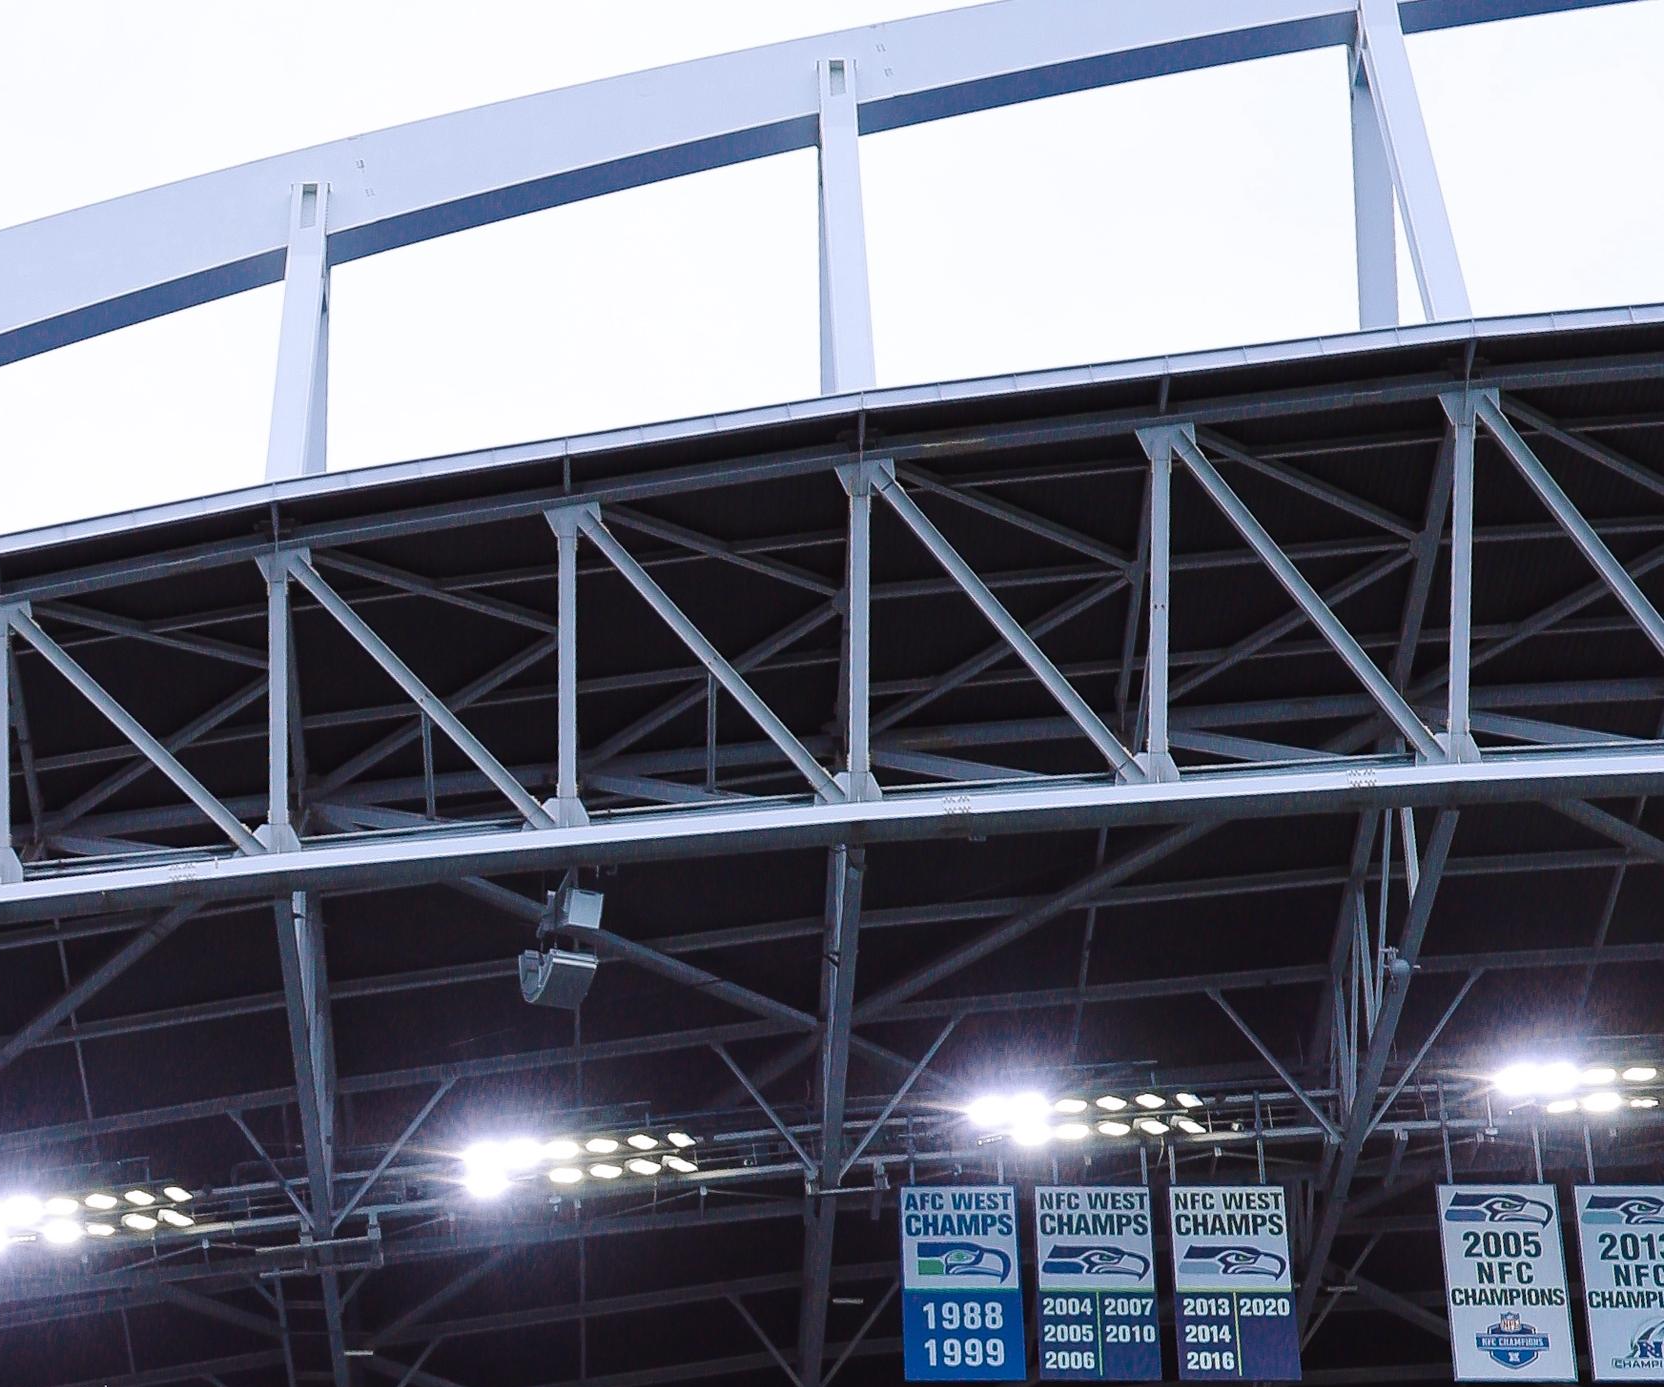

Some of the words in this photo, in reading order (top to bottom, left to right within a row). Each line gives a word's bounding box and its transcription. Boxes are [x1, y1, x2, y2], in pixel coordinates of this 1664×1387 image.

[905, 1193, 944, 1211] AFC
[951, 1193, 1012, 1210] WEST
[1039, 1193, 1080, 1210] NFC
[1088, 1193, 1148, 1210] WEST
[1174, 1193, 1215, 1210] NFC
[1222, 1193, 1283, 1210] WEST
[905, 1213, 1013, 1237] CHAMPS
[1040, 1213, 1149, 1236] CHAMPS
[1175, 1213, 1284, 1236] CHAMPS
[1462, 1231, 1542, 1258] 2005
[1476, 1261, 1534, 1284] NFC
[1451, 1288, 1565, 1306] CHAMPIONS
[923, 1302, 1004, 1330] 1988
[1043, 1298, 1093, 1316] 2004
[1104, 1298, 1154, 1316] 2007
[1183, 1298, 1230, 1316] 2013
[1240, 1298, 1290, 1316] 2020
[1043, 1325, 1094, 1342] 2005
[1106, 1325, 1156, 1343] 2010
[1185, 1325, 1232, 1343] 2014
[924, 1338, 1005, 1367] 1999
[1045, 1351, 1095, 1370] 2006
[1187, 1352, 1235, 1370] 2016
